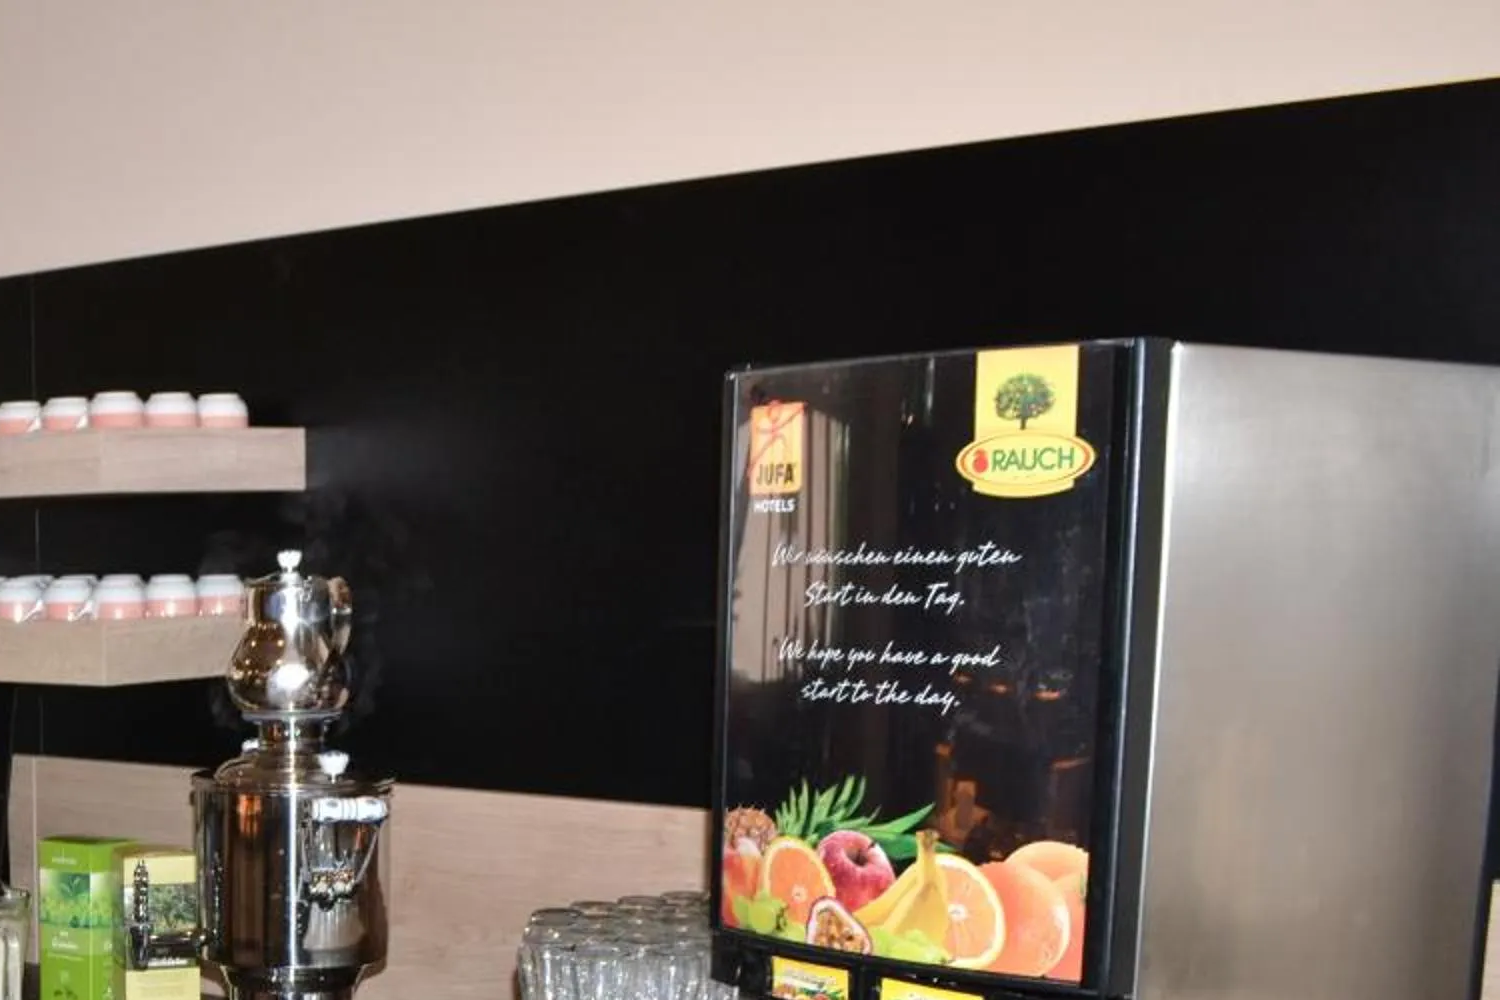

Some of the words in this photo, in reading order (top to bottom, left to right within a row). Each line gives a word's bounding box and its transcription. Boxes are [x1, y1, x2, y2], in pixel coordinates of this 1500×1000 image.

[756, 463, 795, 486] JUFA
[991, 446, 1075, 472] RAUCH
[753, 498, 796, 513] HOTELS
[893, 546, 956, 565] einen
[954, 540, 1022, 574] guten
[804, 581, 856, 608] Start
[855, 586, 881, 605] in
[880, 583, 923, 605] den
[924, 582, 965, 615] Tag.
[779, 637, 806, 660] We
[806, 639, 845, 669] hope
[847, 648, 876, 671] you
[879, 640, 928, 665] have
[929, 652, 950, 665] a
[948, 644, 1001, 675] good
[801, 678, 851, 703] start
[851, 679, 873, 703] to
[875, 680, 912, 705] the
[914, 683, 961, 716] day.
